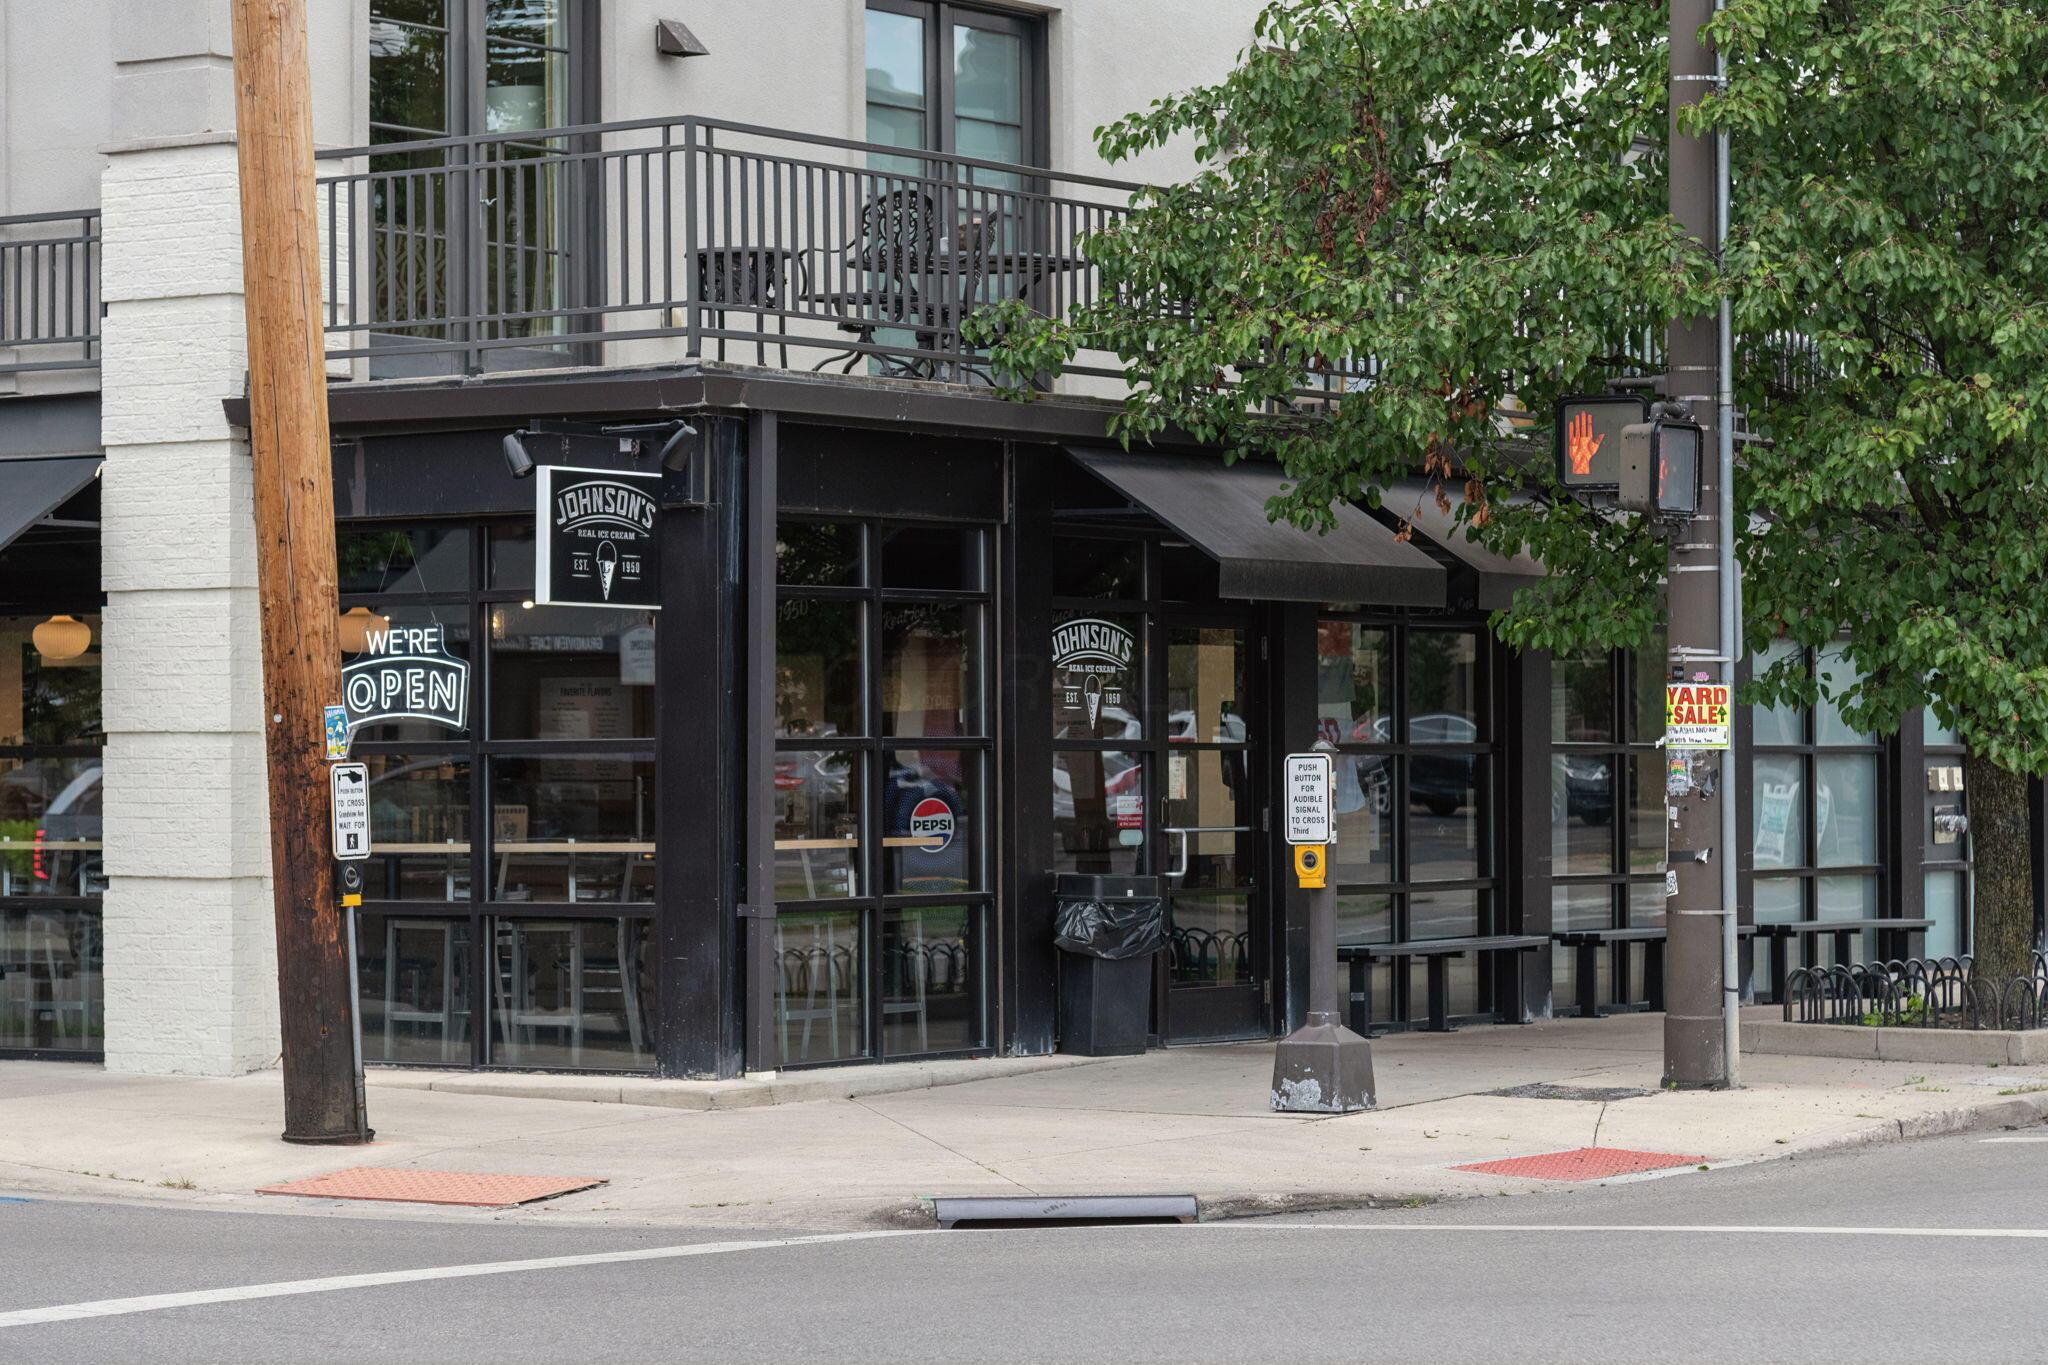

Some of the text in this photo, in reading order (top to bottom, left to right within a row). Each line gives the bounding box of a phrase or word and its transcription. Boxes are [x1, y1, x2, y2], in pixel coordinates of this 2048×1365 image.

[556, 486, 656, 529] JOHNSON'S
[578, 529, 635, 540] REAL ICE CREAM
[574, 559, 640, 573] EST. 1950
[366, 628, 438, 655] WE'RE
[1052, 624, 1133, 662] JOHNSON'S
[1068, 664, 1116, 673] REAL ICE CREAM
[347, 668, 457, 713] OPEN
[1666, 687, 1727, 705] YARD
[1066, 692, 1120, 704] EST. 1950
[1673, 705, 1718, 724] SALE
[1294, 774, 1321, 782] BUTTON
[337, 799, 365, 807] TO CROSS
[1293, 795, 1323, 803] AUDIBLE
[339, 821, 365, 830] WAIT FOR
[913, 819, 952, 831] PEPSI
[1292, 816, 1325, 824] TO CROSS
[1293, 827, 1309, 835] Third
